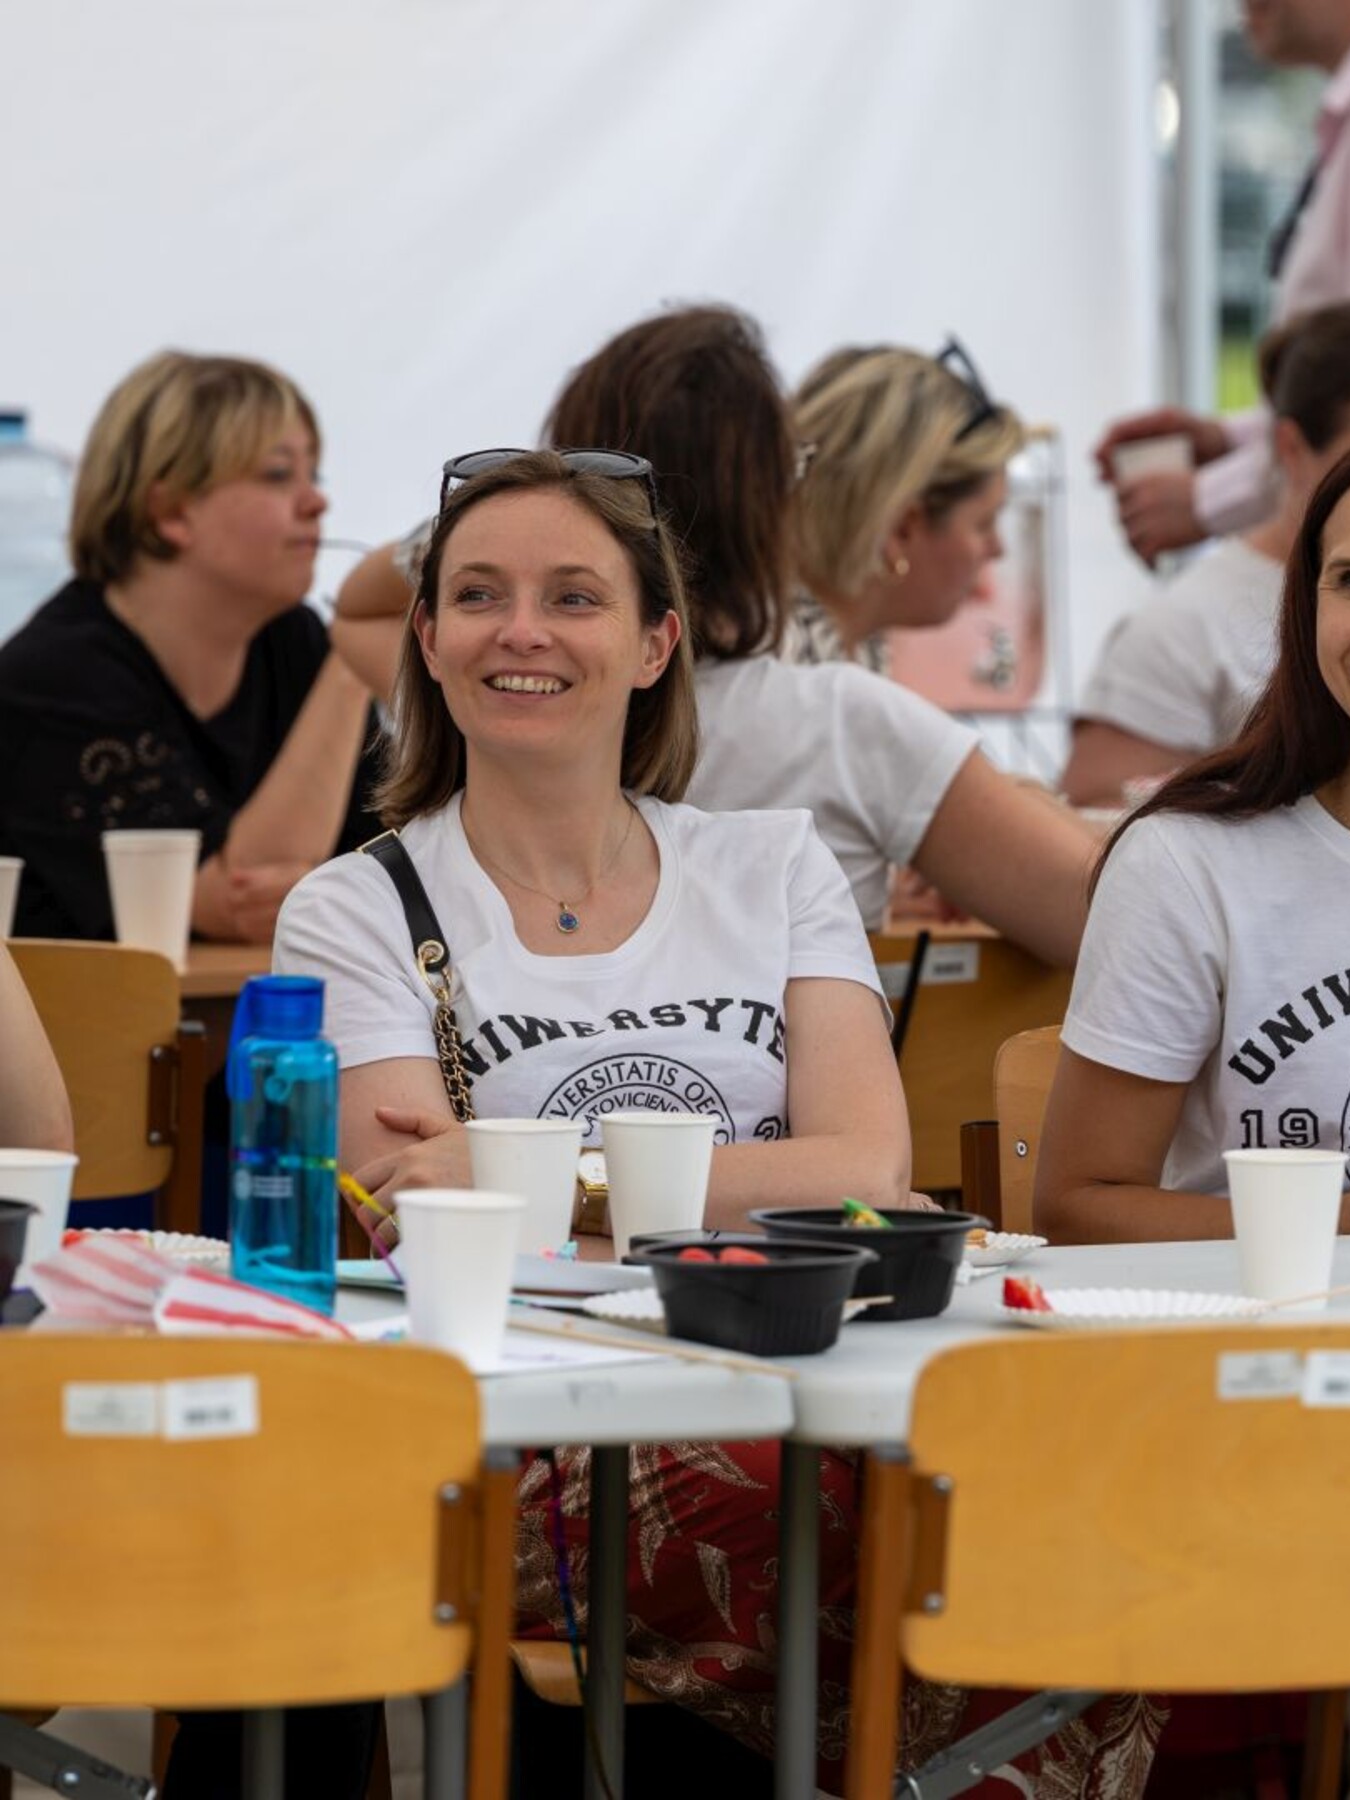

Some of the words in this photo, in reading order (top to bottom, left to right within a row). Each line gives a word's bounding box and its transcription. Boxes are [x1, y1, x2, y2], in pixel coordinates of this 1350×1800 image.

[459, 998, 785, 1087] NIWERSYTE
[546, 1060, 679, 1120] VERSITATIS
[1240, 1107, 1320, 1149] 19
